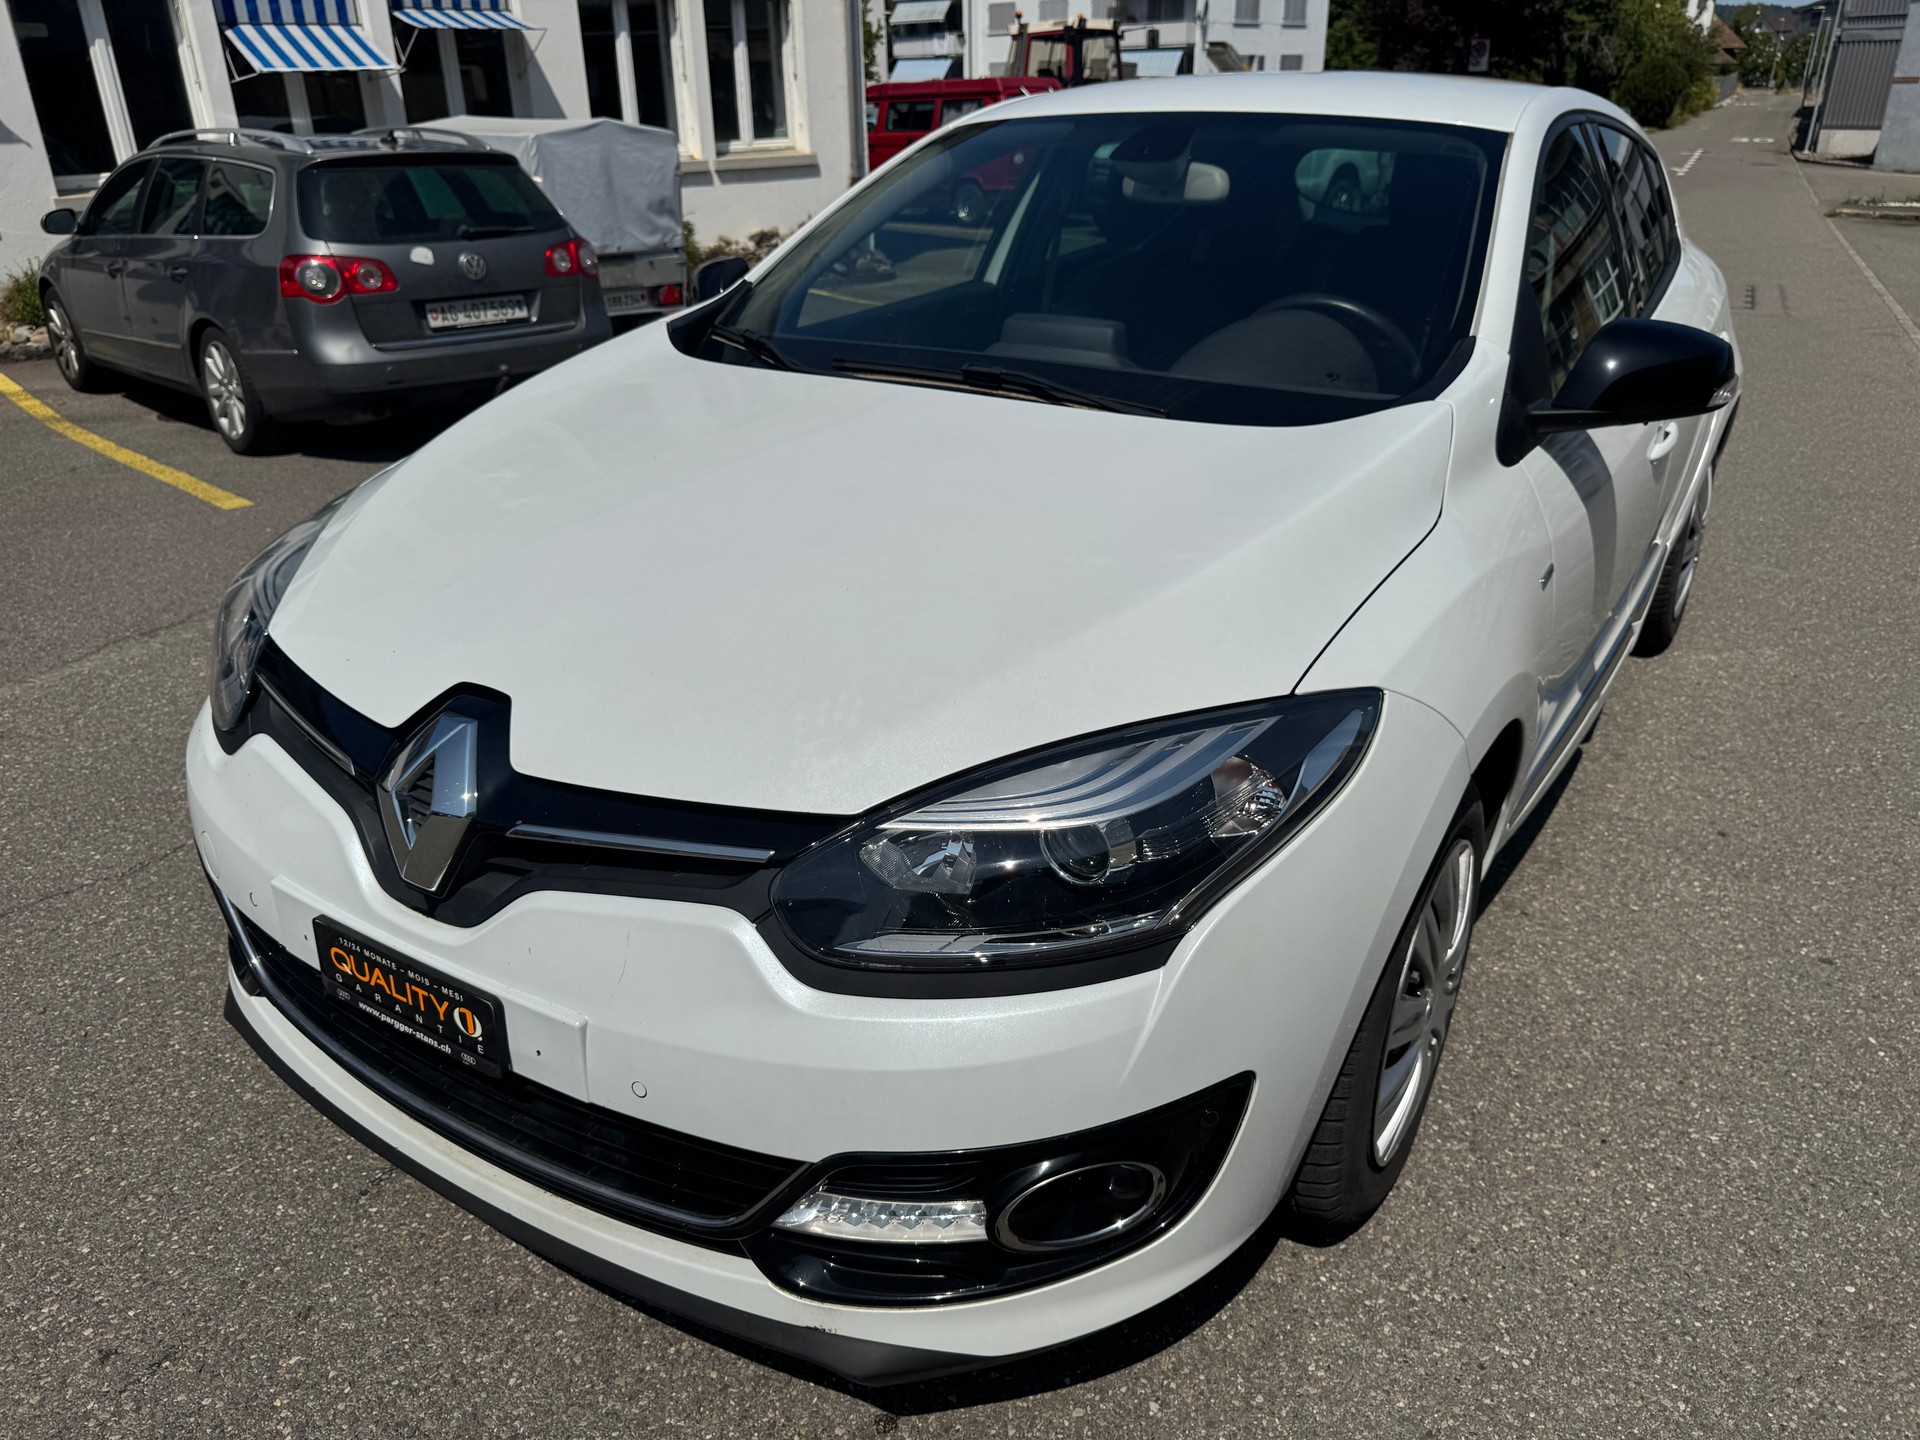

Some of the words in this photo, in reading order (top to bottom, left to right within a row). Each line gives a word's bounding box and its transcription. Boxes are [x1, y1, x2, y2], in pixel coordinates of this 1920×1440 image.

[440, 304, 459, 322] AG
[330, 947, 449, 1021] QUALITY
[339, 937, 361, 953] 12/24
[363, 948, 397, 970] MONATE
[407, 970, 430, 987] MOIS
[441, 986, 464, 1002] MESI
[335, 973, 485, 1054] GARANTIE
[358, 1001, 452, 1055] www.pargger-stans.ch
